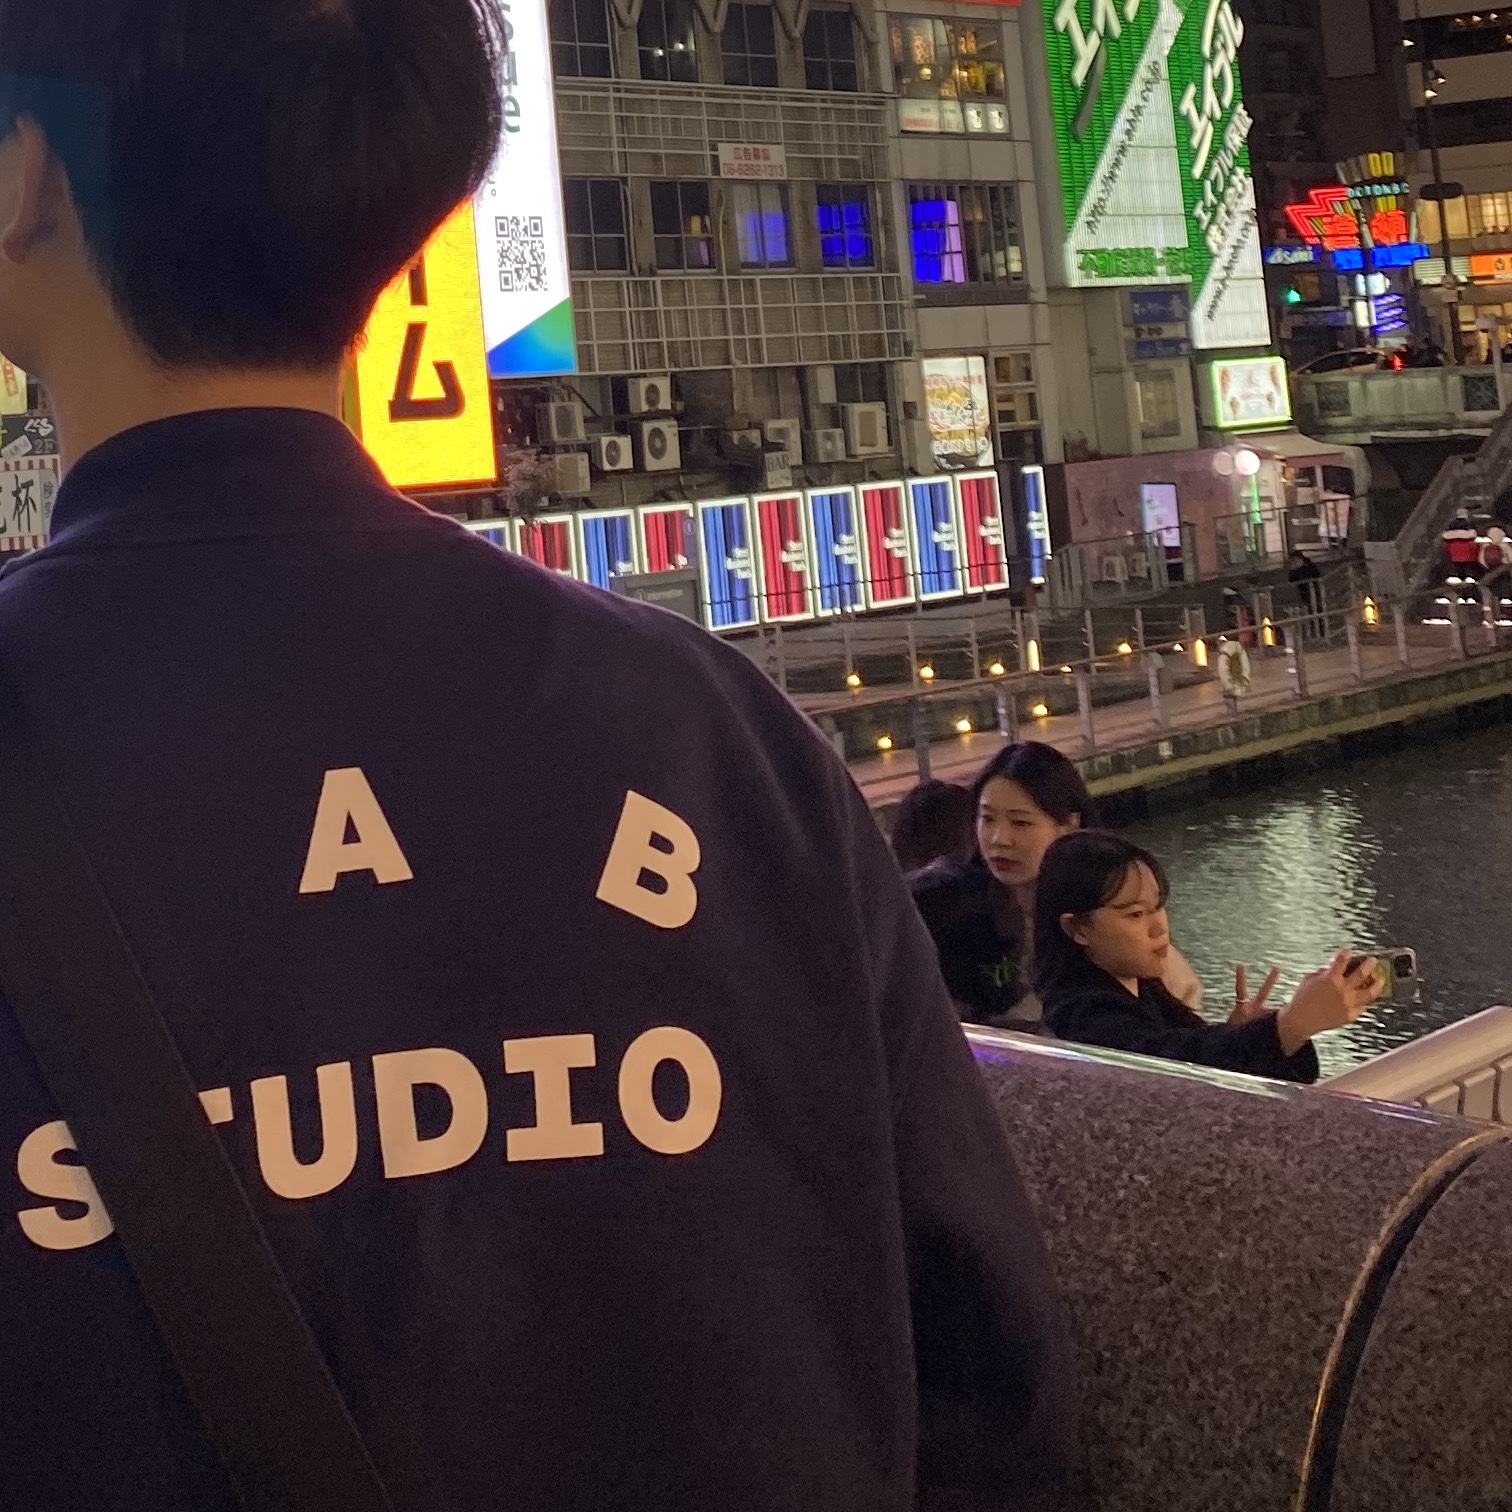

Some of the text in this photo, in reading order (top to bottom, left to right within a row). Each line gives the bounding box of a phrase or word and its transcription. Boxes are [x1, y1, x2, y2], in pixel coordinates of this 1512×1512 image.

[1178, 1, 1245, 150] エイブル
[298, 766, 702, 930] A B
[17, 1025, 723, 1251] SUDIO
